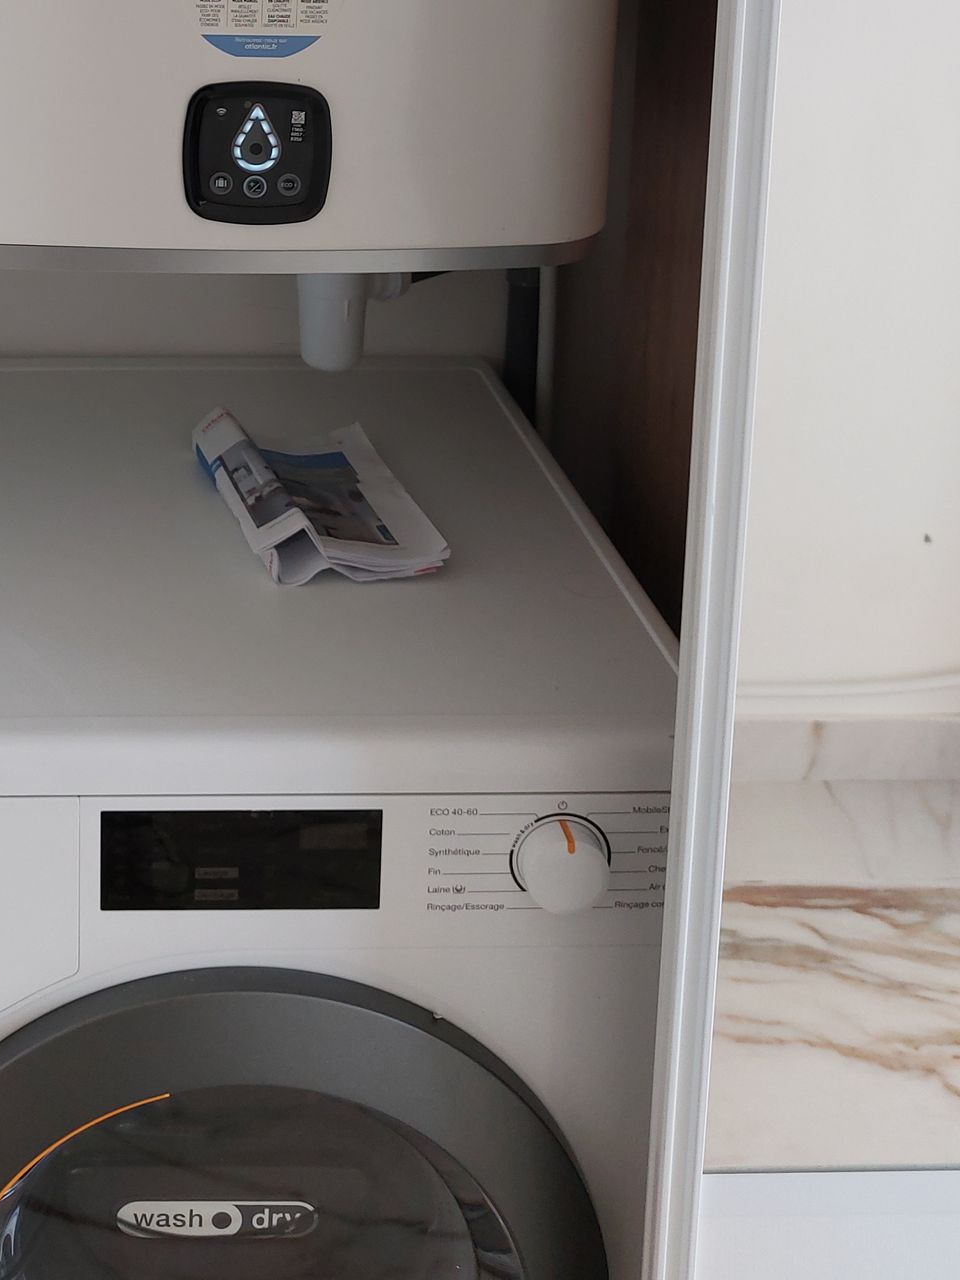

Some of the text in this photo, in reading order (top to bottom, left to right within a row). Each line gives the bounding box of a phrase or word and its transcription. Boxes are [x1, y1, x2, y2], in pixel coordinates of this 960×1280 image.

[429, 807, 478, 816] ECO 40-60
[429, 828, 456, 837] Coton
[428, 848, 481, 857] Synthétique
[427, 867, 441, 876] Fin
[427, 885, 451, 894] Laine
[426, 903, 505, 912] Rinçage/Essorage
[614, 901, 650, 910] Rinçage
[133, 1207, 302, 1233] wash dry
